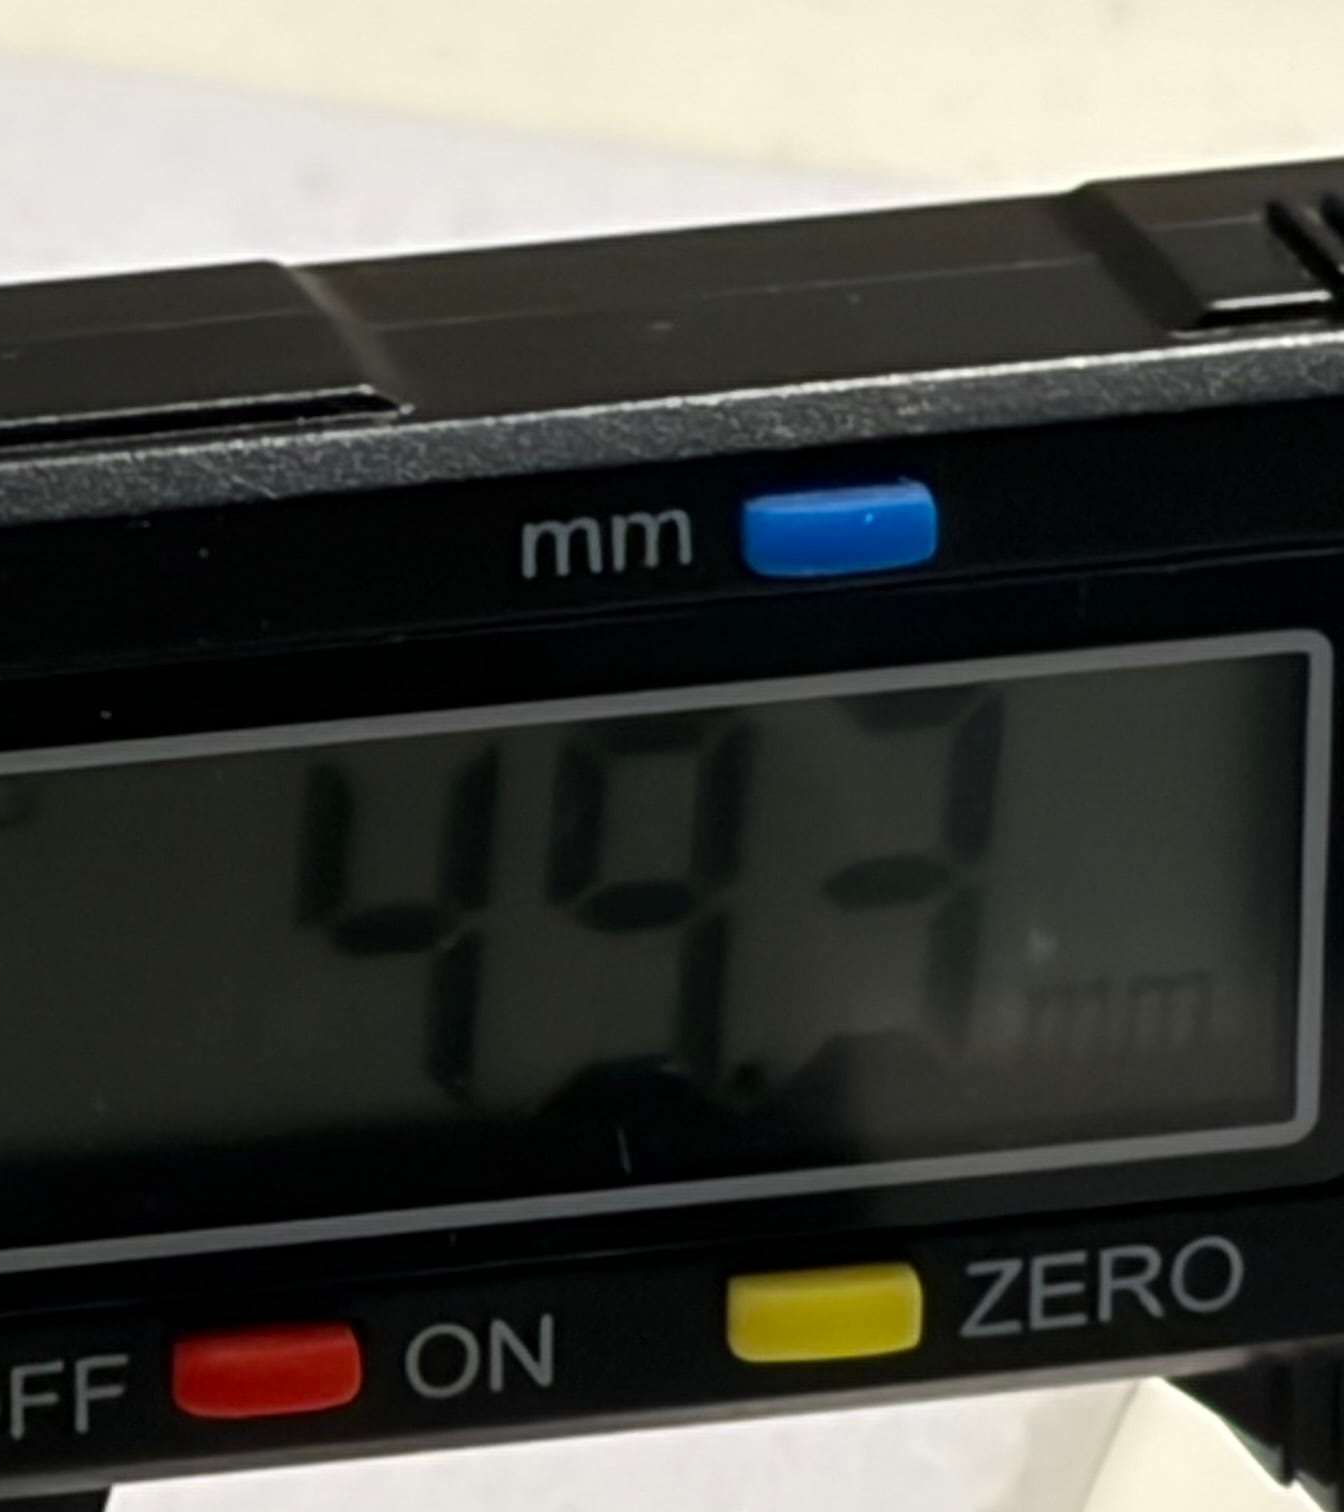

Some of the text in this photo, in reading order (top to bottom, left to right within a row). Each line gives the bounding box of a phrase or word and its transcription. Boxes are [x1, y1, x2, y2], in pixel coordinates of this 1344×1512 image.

[520, 507, 694, 578] mm
[959, 1234, 1246, 1339] ZERO
[403, 1313, 556, 1400] ON
